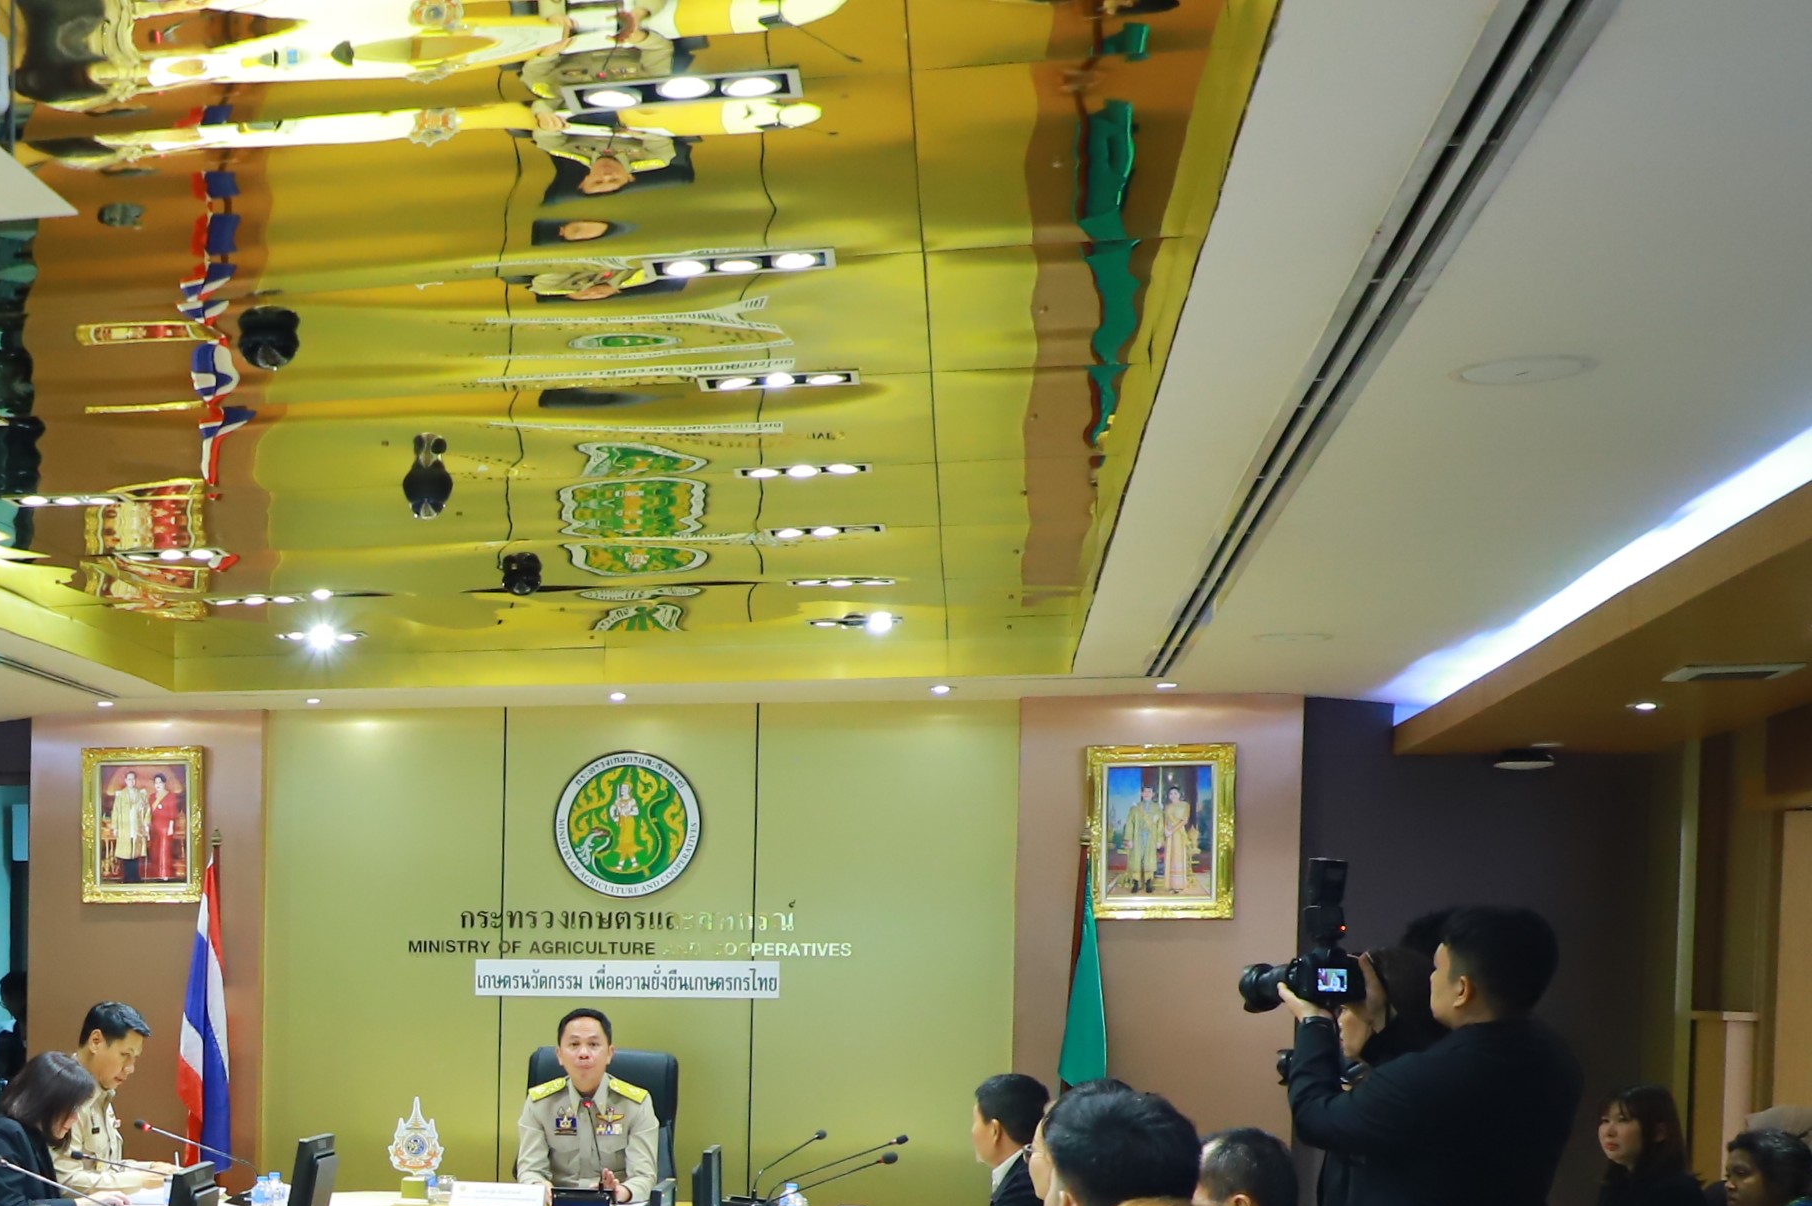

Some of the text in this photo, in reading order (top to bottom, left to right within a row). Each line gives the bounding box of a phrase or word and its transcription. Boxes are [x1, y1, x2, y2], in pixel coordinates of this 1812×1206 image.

[558, 818, 697, 895] MINISTRY OF AGRICULTURE AND COOPERATIVES
[408, 940, 490, 954] MINISTRY
[498, 940, 522, 955] OF
[529, 941, 656, 956] AGRICULTURE
[477, 963, 778, 992] เกษตรนวัตกรรม เพื่อความยั่งยืนเกษตรกรไทย
